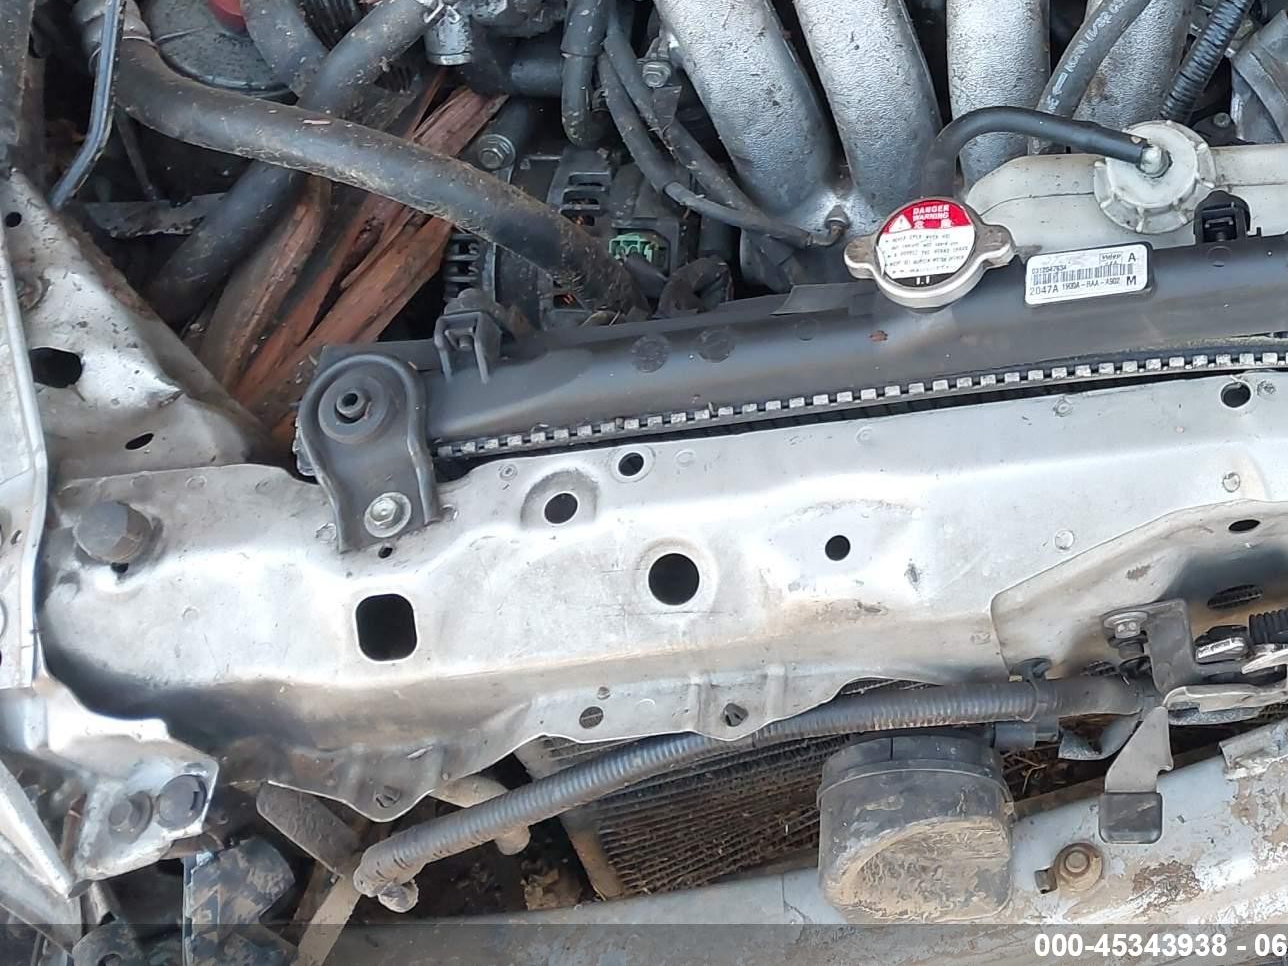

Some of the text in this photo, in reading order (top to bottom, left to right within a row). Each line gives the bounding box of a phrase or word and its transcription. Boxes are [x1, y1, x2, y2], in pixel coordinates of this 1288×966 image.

[912, 204, 949, 214] DANGER
[912, 212, 949, 222] WARNING
[1128, 252, 1137, 263] A
[1127, 275, 1137, 286] M
[1029, 285, 1059, 296] 2047A
